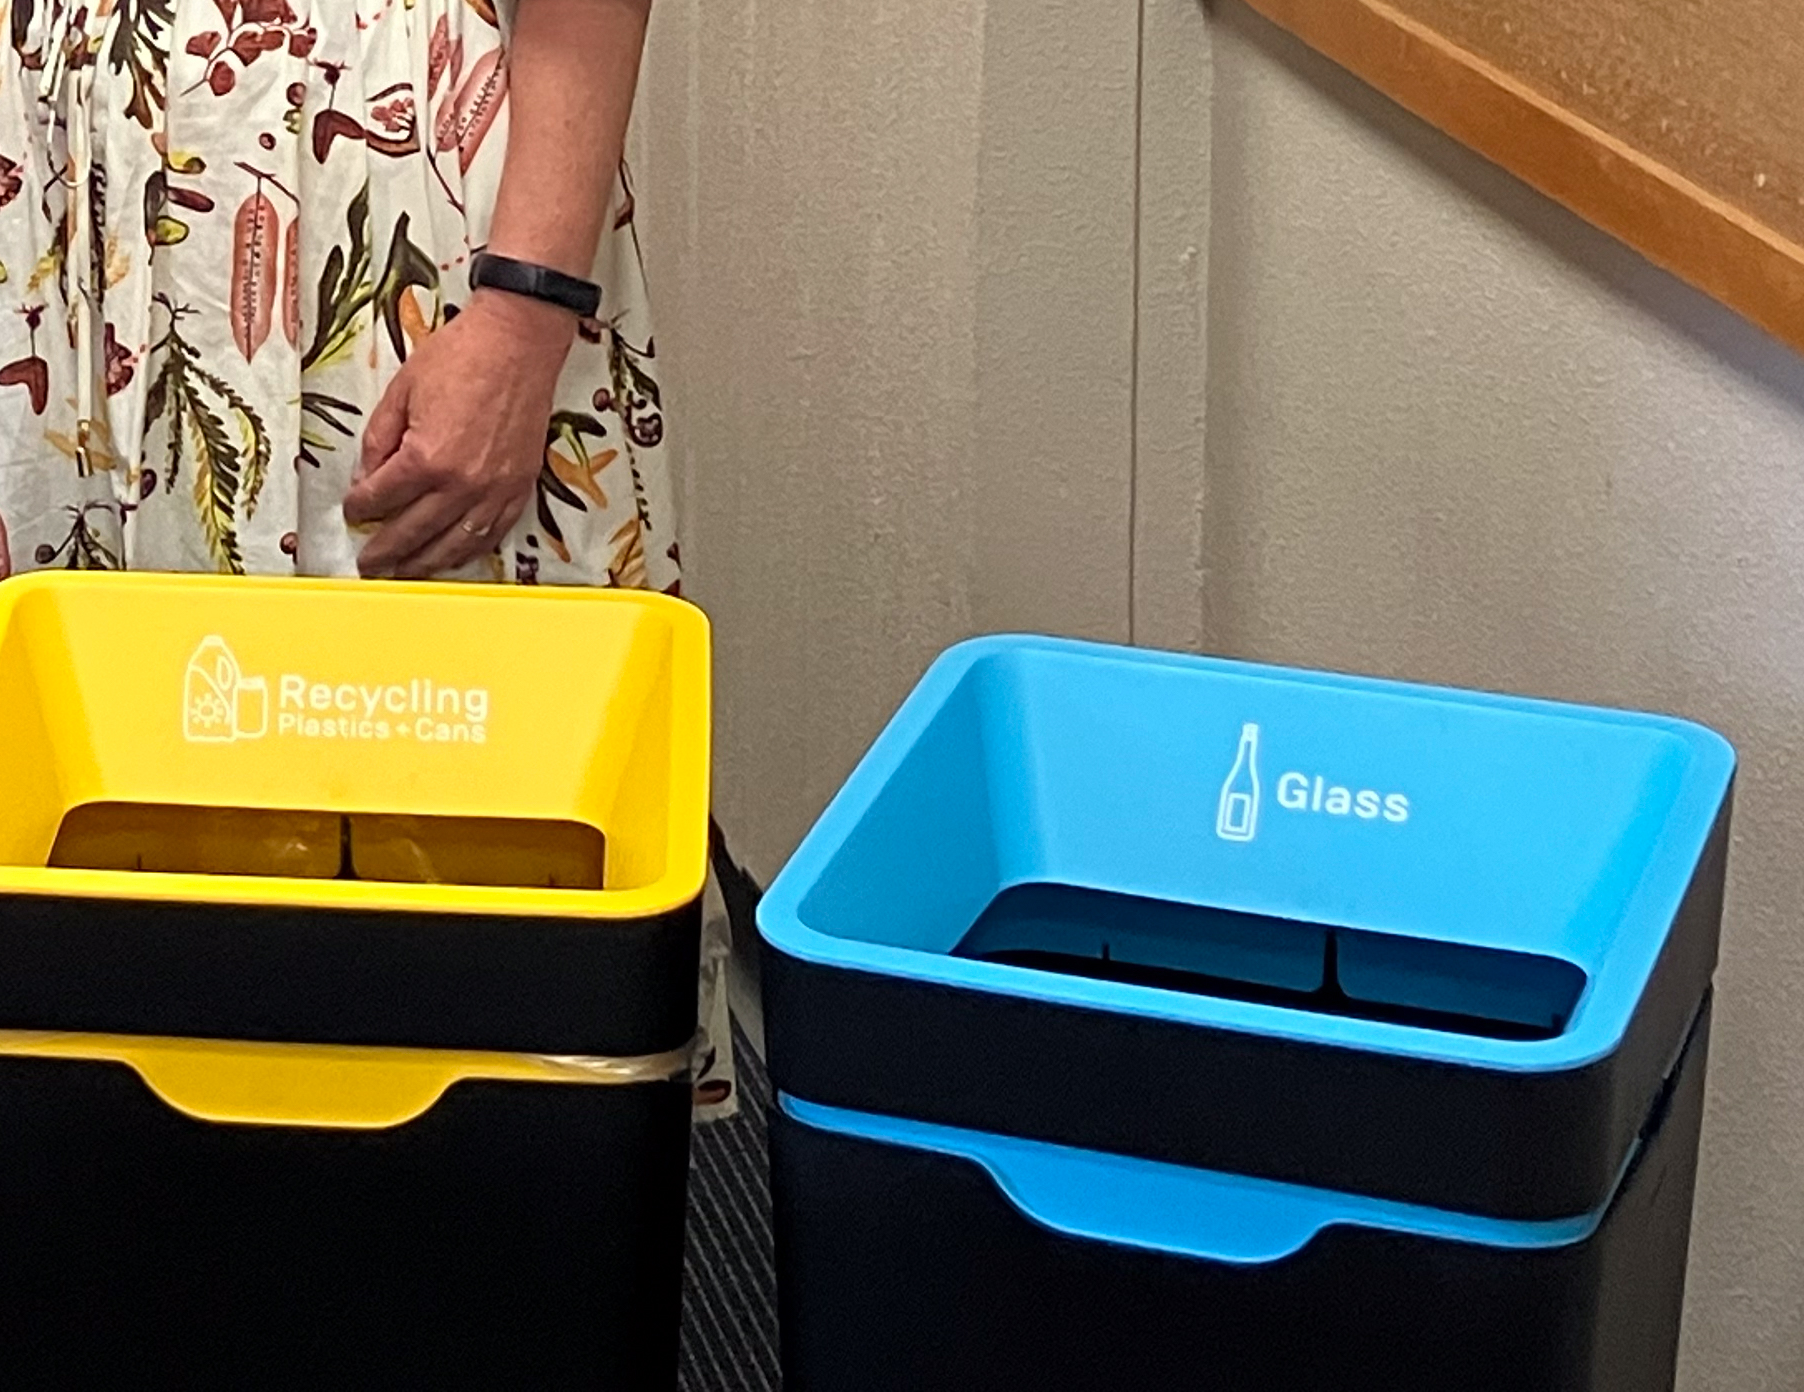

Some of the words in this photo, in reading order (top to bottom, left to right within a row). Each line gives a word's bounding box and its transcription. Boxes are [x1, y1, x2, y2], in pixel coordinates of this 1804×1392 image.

[280, 674, 488, 722] Recycling
[278, 712, 389, 739] Plastics
[414, 716, 487, 744] Cans
[1276, 771, 1410, 822] Glass
